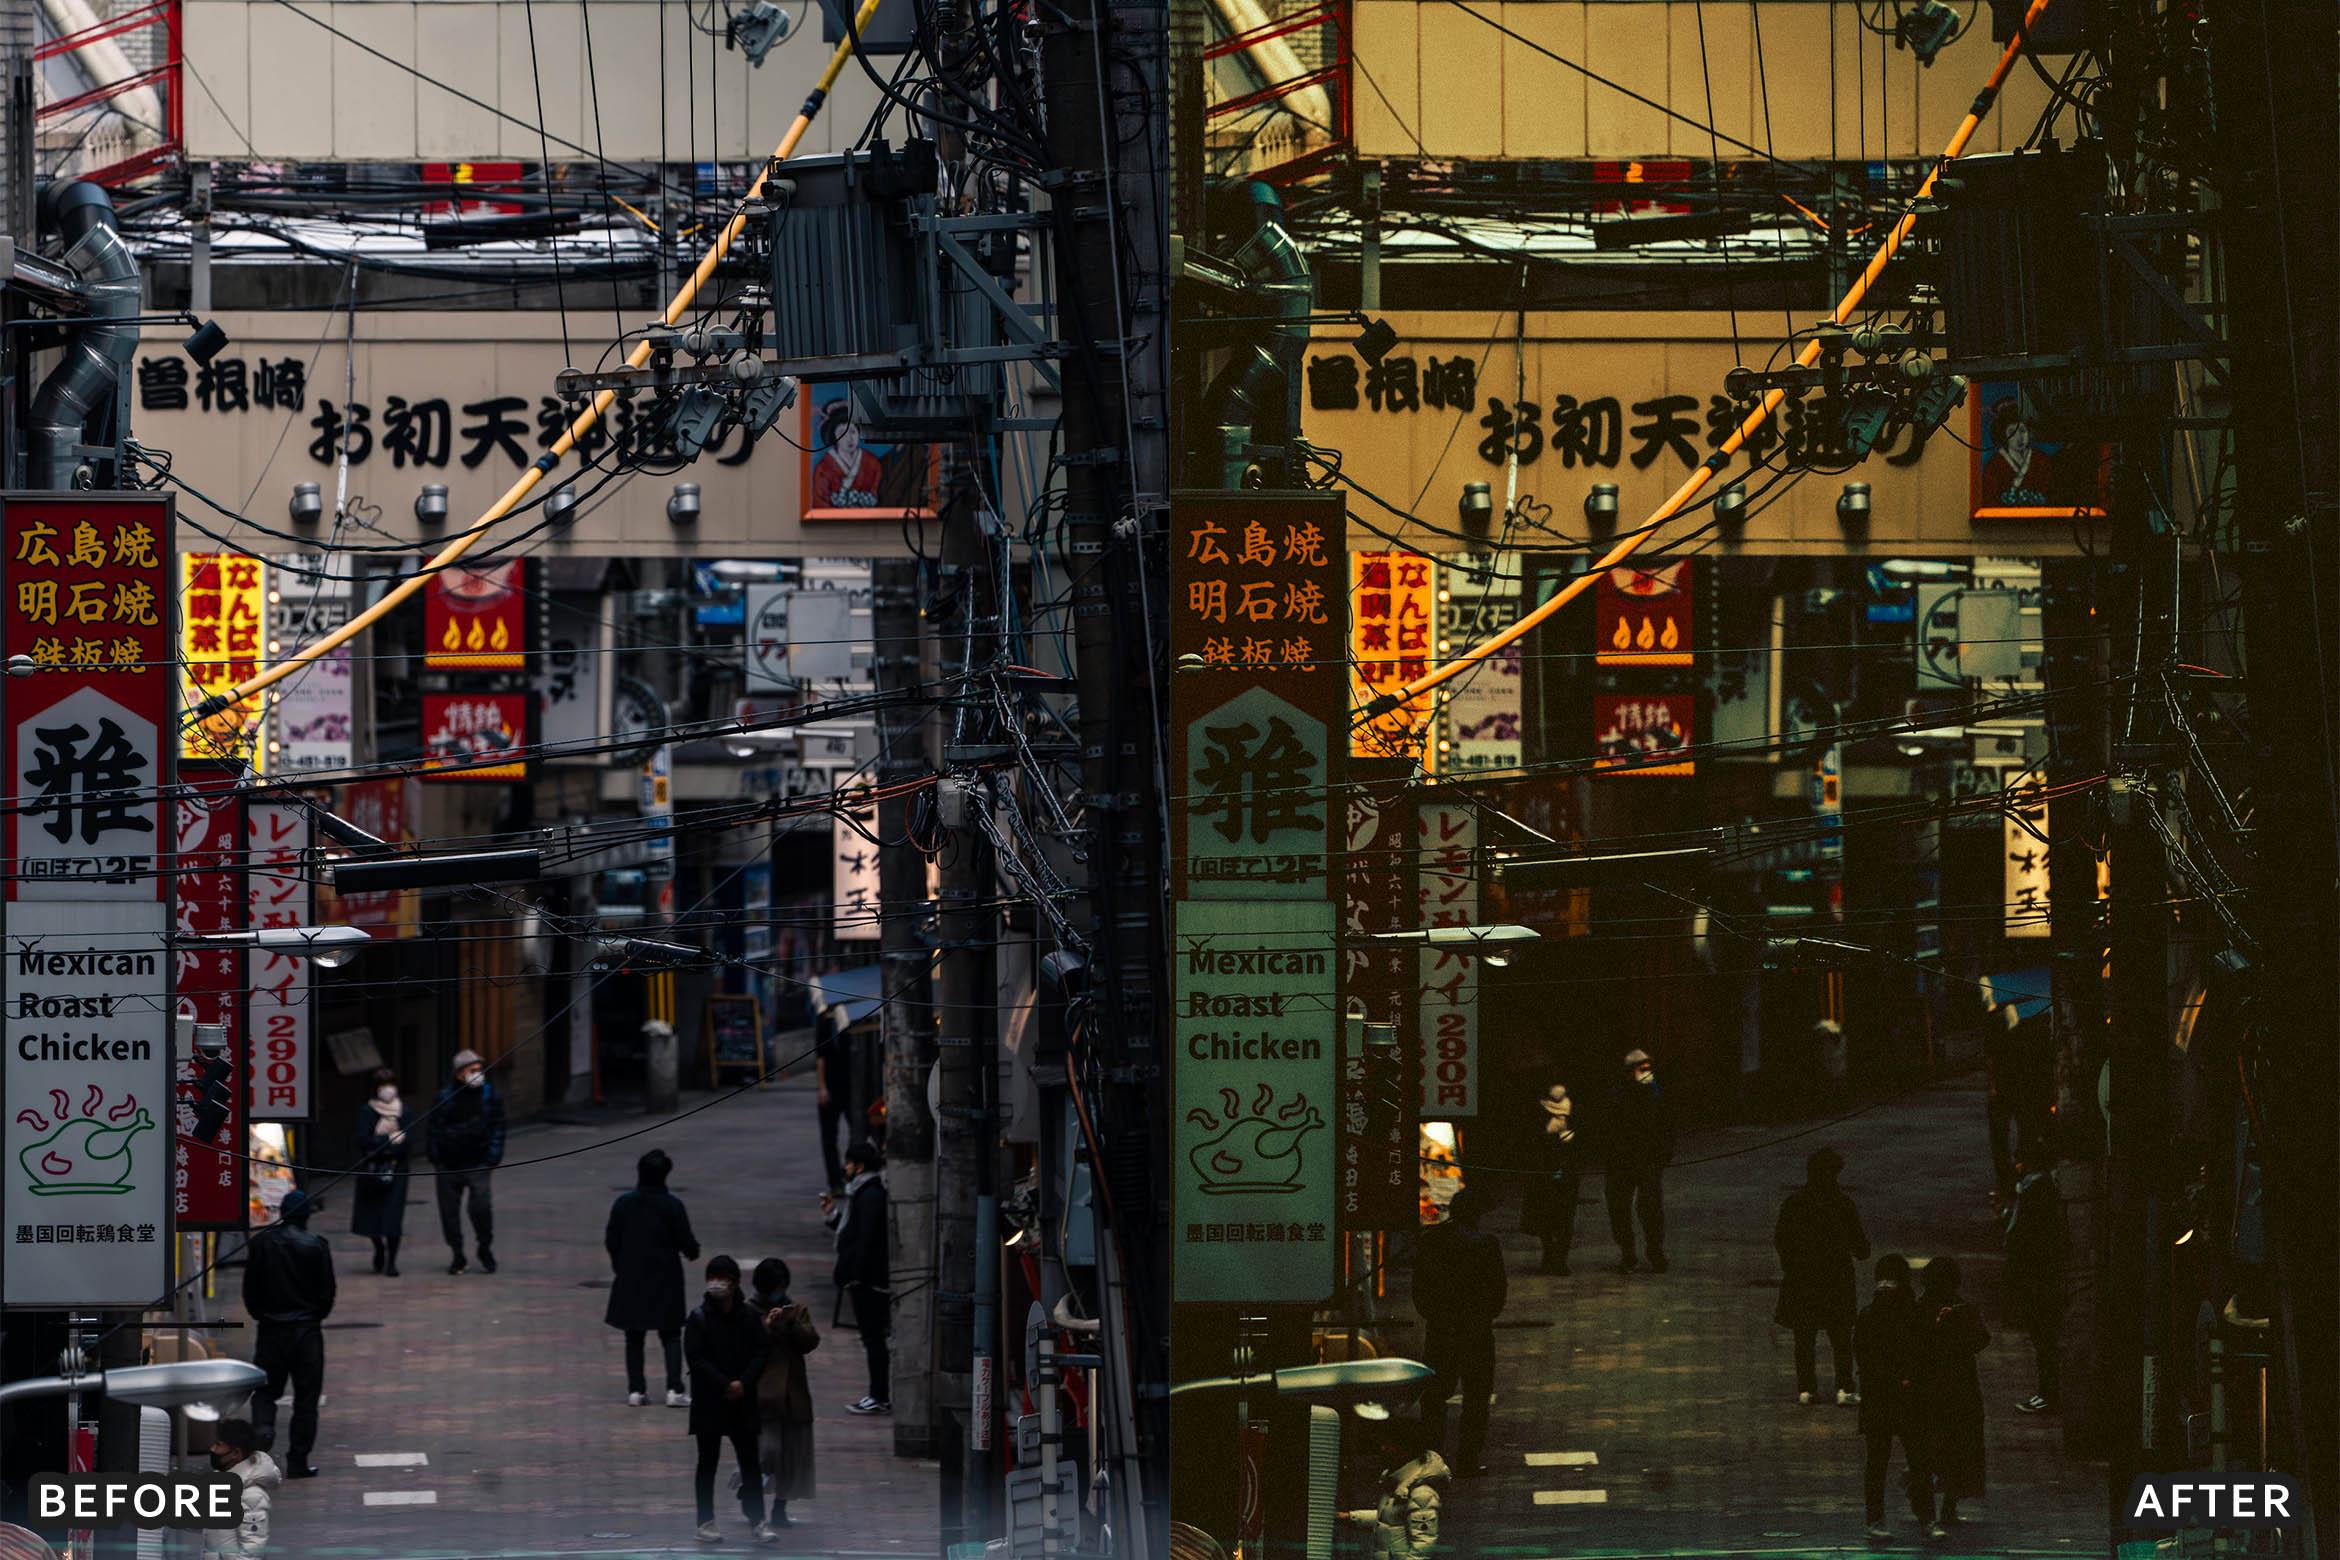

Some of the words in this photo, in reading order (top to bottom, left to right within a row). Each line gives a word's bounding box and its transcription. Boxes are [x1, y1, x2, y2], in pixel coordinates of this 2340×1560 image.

[16, 520, 160, 569] 広島焼
[1186, 519, 1330, 568] 広島焼
[17, 579, 160, 626] 明石焼
[1187, 578, 1330, 625] 明石焼
[31, 635, 147, 674] 鉄板焼
[1201, 634, 1317, 673] 鉄板焼
[23, 717, 154, 845] 雅
[1193, 716, 1324, 844] 雅
[19, 946, 155, 976] Mexican
[1189, 945, 1325, 975] Mexican
[19, 992, 114, 1018] Roast
[1189, 991, 1284, 1017] Roast
[18, 1032, 151, 1061] Chicken
[1188, 1031, 1321, 1060] Chicken
[15, 1224, 156, 1243] 墨国回転鶏食堂
